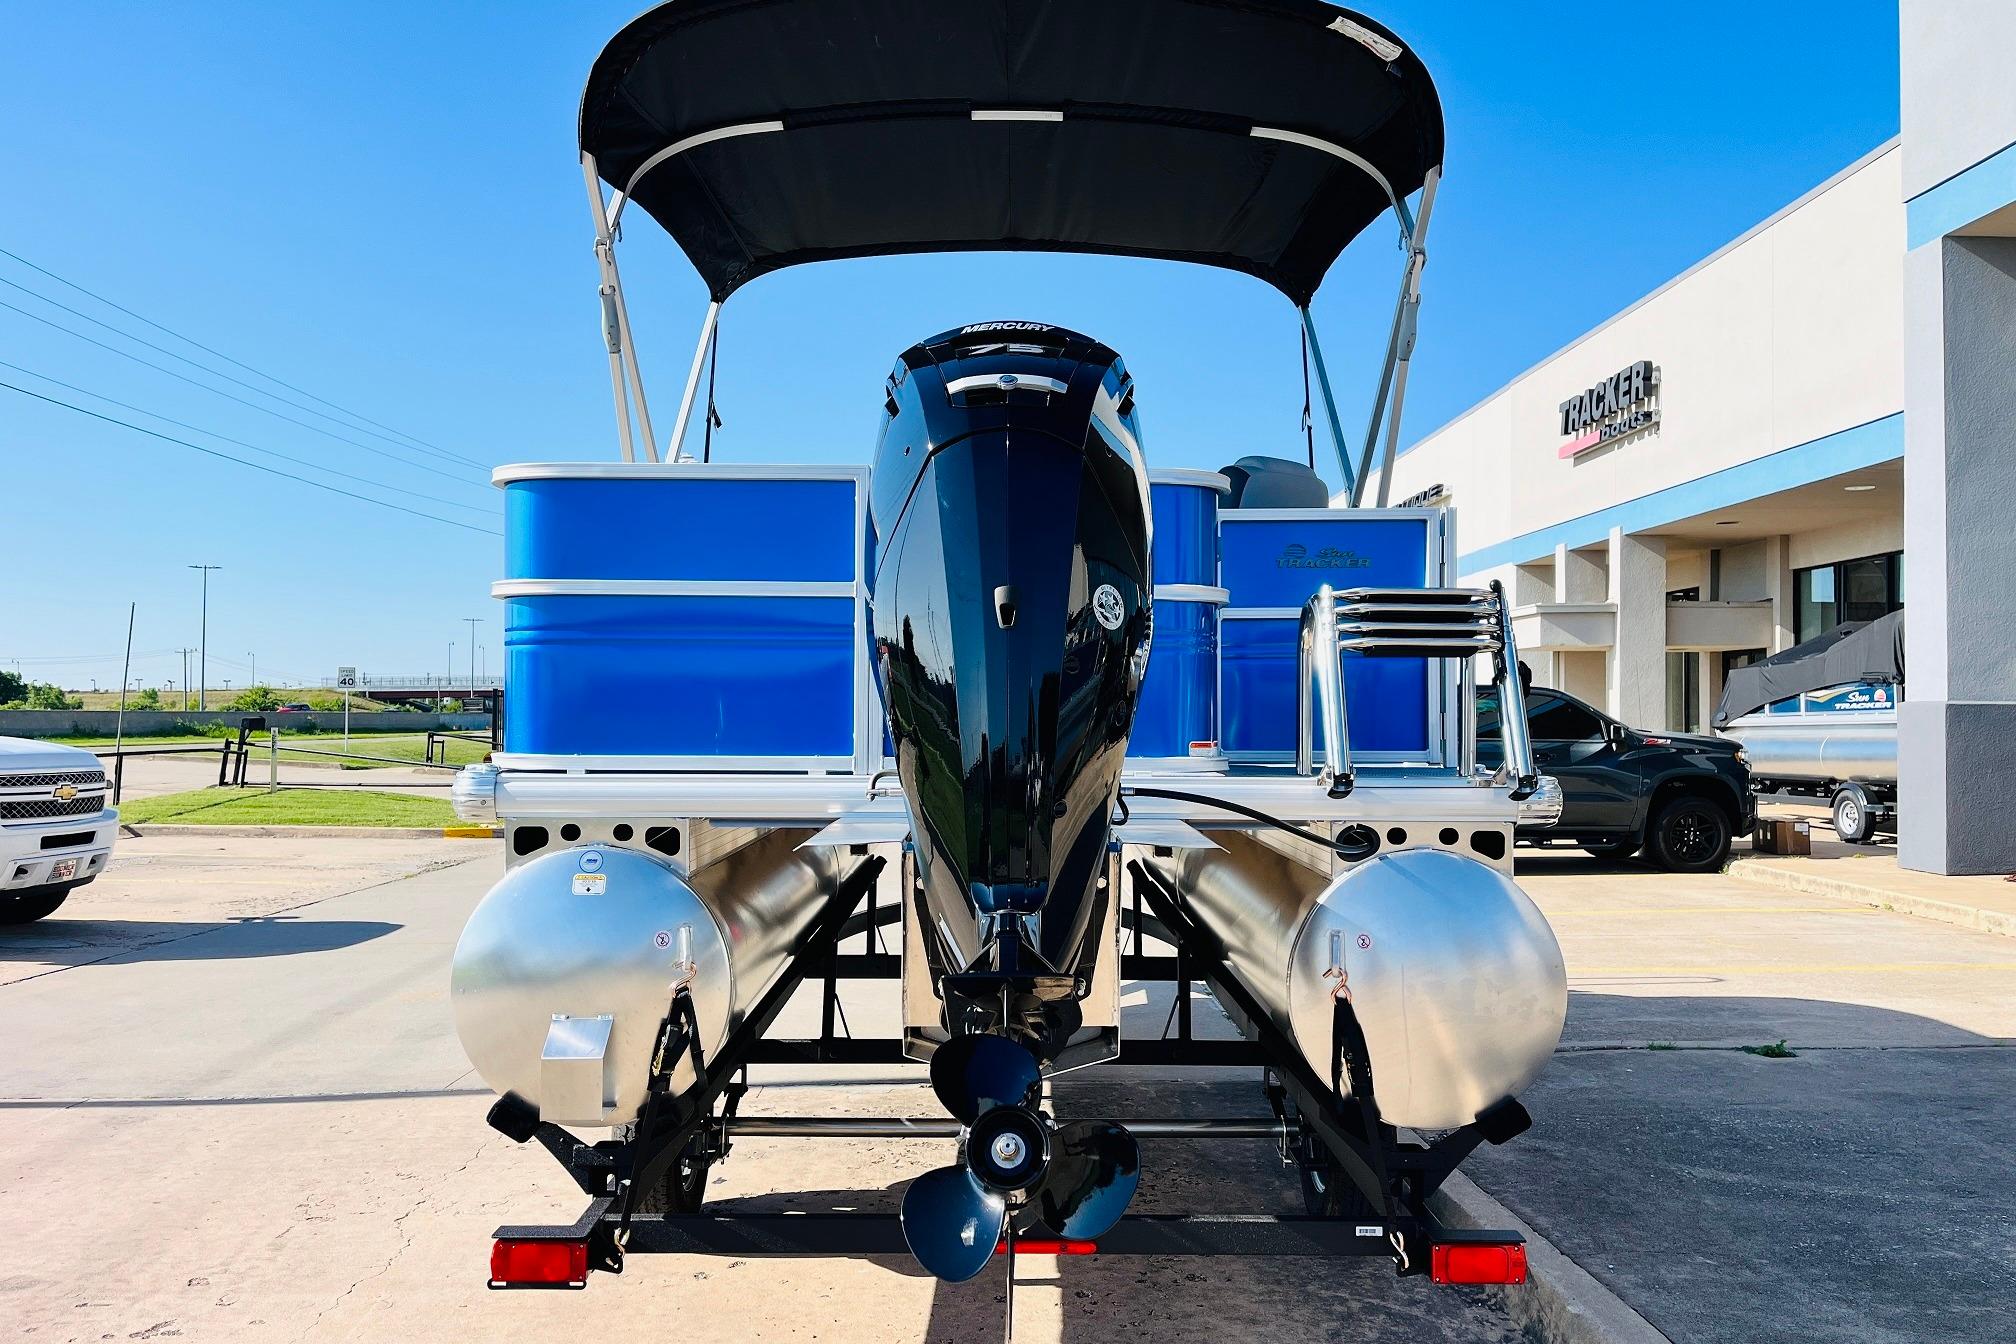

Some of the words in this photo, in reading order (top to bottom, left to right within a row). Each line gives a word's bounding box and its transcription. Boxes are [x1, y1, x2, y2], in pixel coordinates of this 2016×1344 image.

[961, 322, 1055, 334] MERCURY
[968, 343, 1044, 355] 75
[1559, 360, 1653, 436] TRACKER
[1600, 411, 1648, 442] boats
[1276, 559, 1370, 568] TRACKER
[1846, 691, 1870, 702] Sun
[1834, 702, 1892, 710] TRACKER
